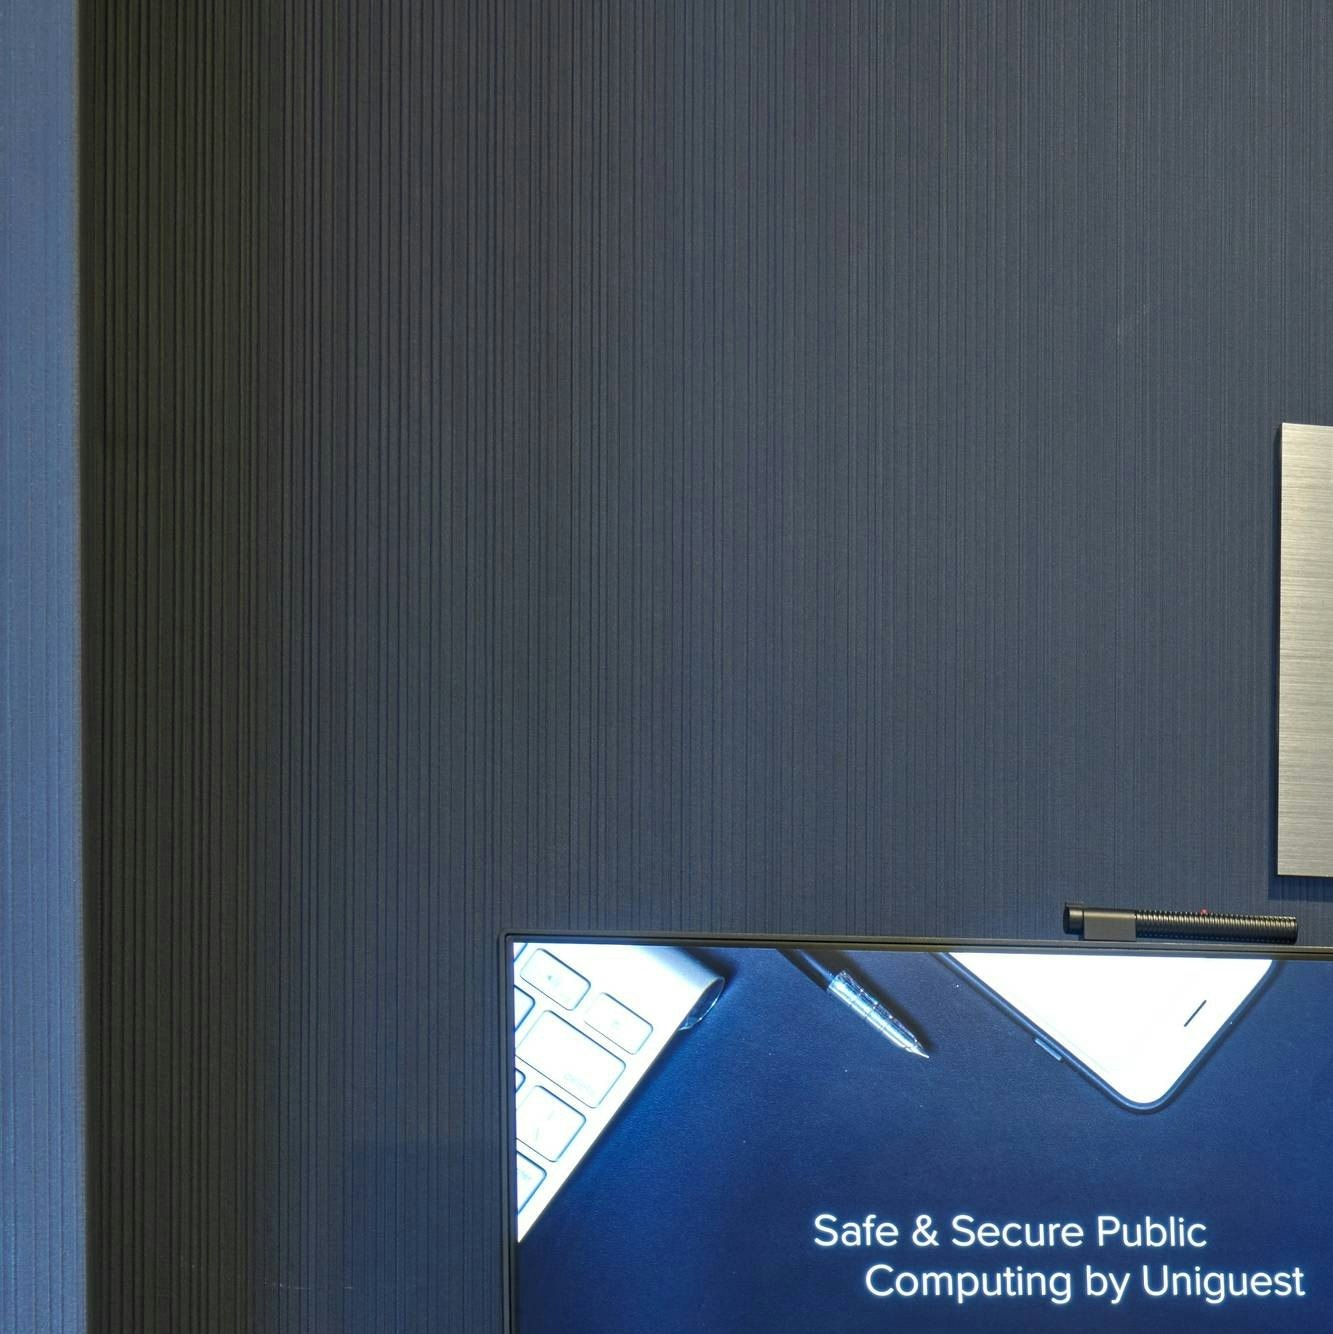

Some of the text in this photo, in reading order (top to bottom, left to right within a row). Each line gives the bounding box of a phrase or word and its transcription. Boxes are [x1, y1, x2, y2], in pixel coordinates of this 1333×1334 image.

[813, 1213, 1207, 1248] Safe & Secure Public
[865, 1264, 1306, 1304] Computing by Uniguest
